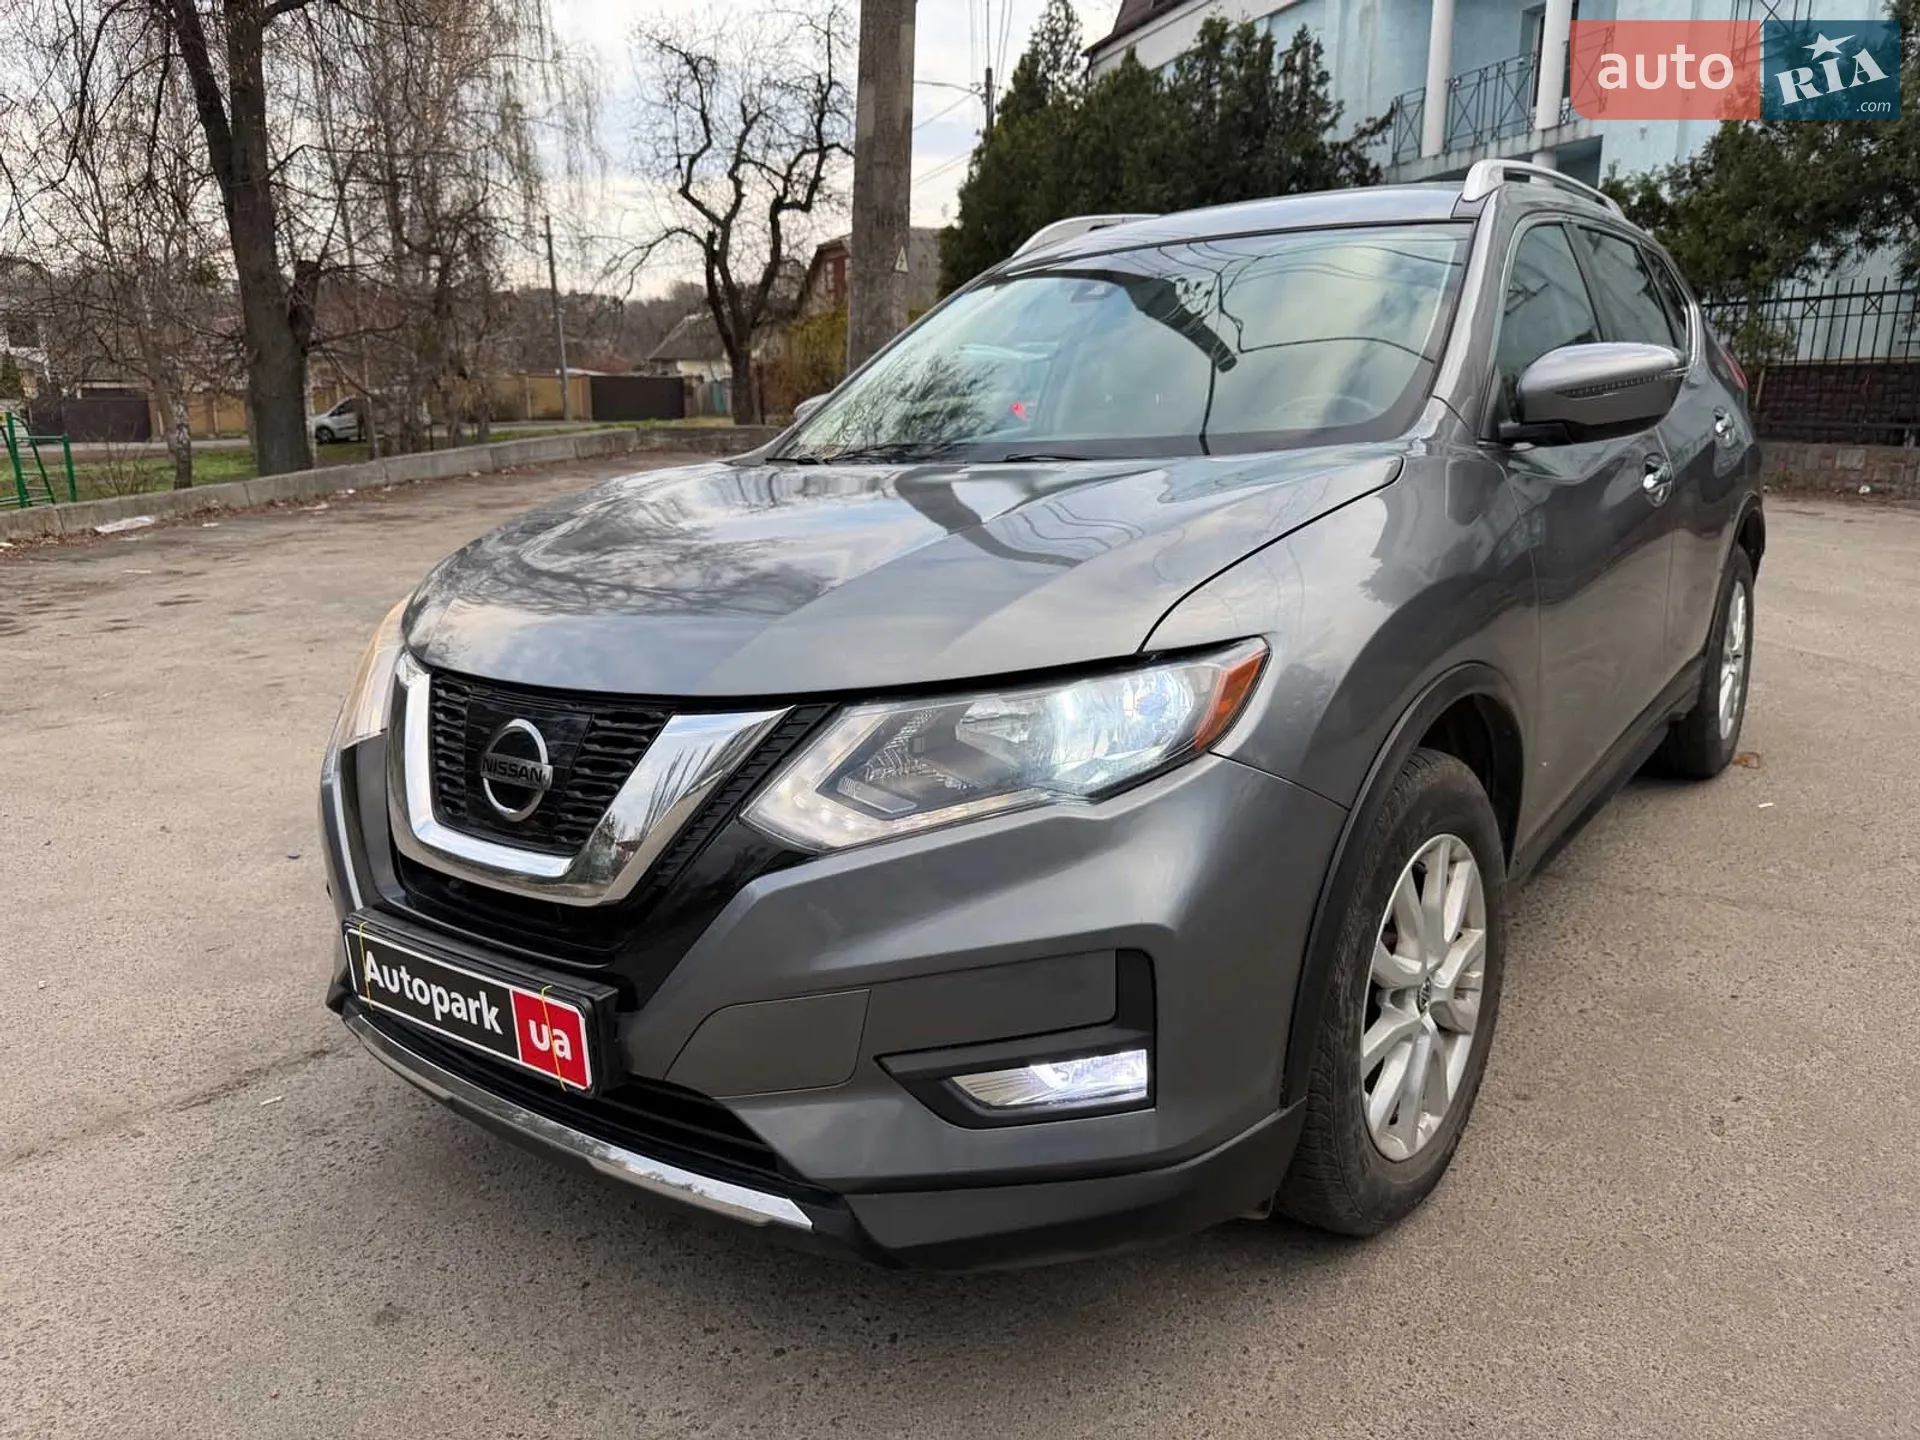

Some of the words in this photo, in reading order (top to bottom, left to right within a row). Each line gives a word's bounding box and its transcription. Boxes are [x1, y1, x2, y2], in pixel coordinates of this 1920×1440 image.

[482, 758, 543, 783] NISSAN
[364, 950, 503, 1035] Autopark
[528, 1019, 572, 1061] ua
